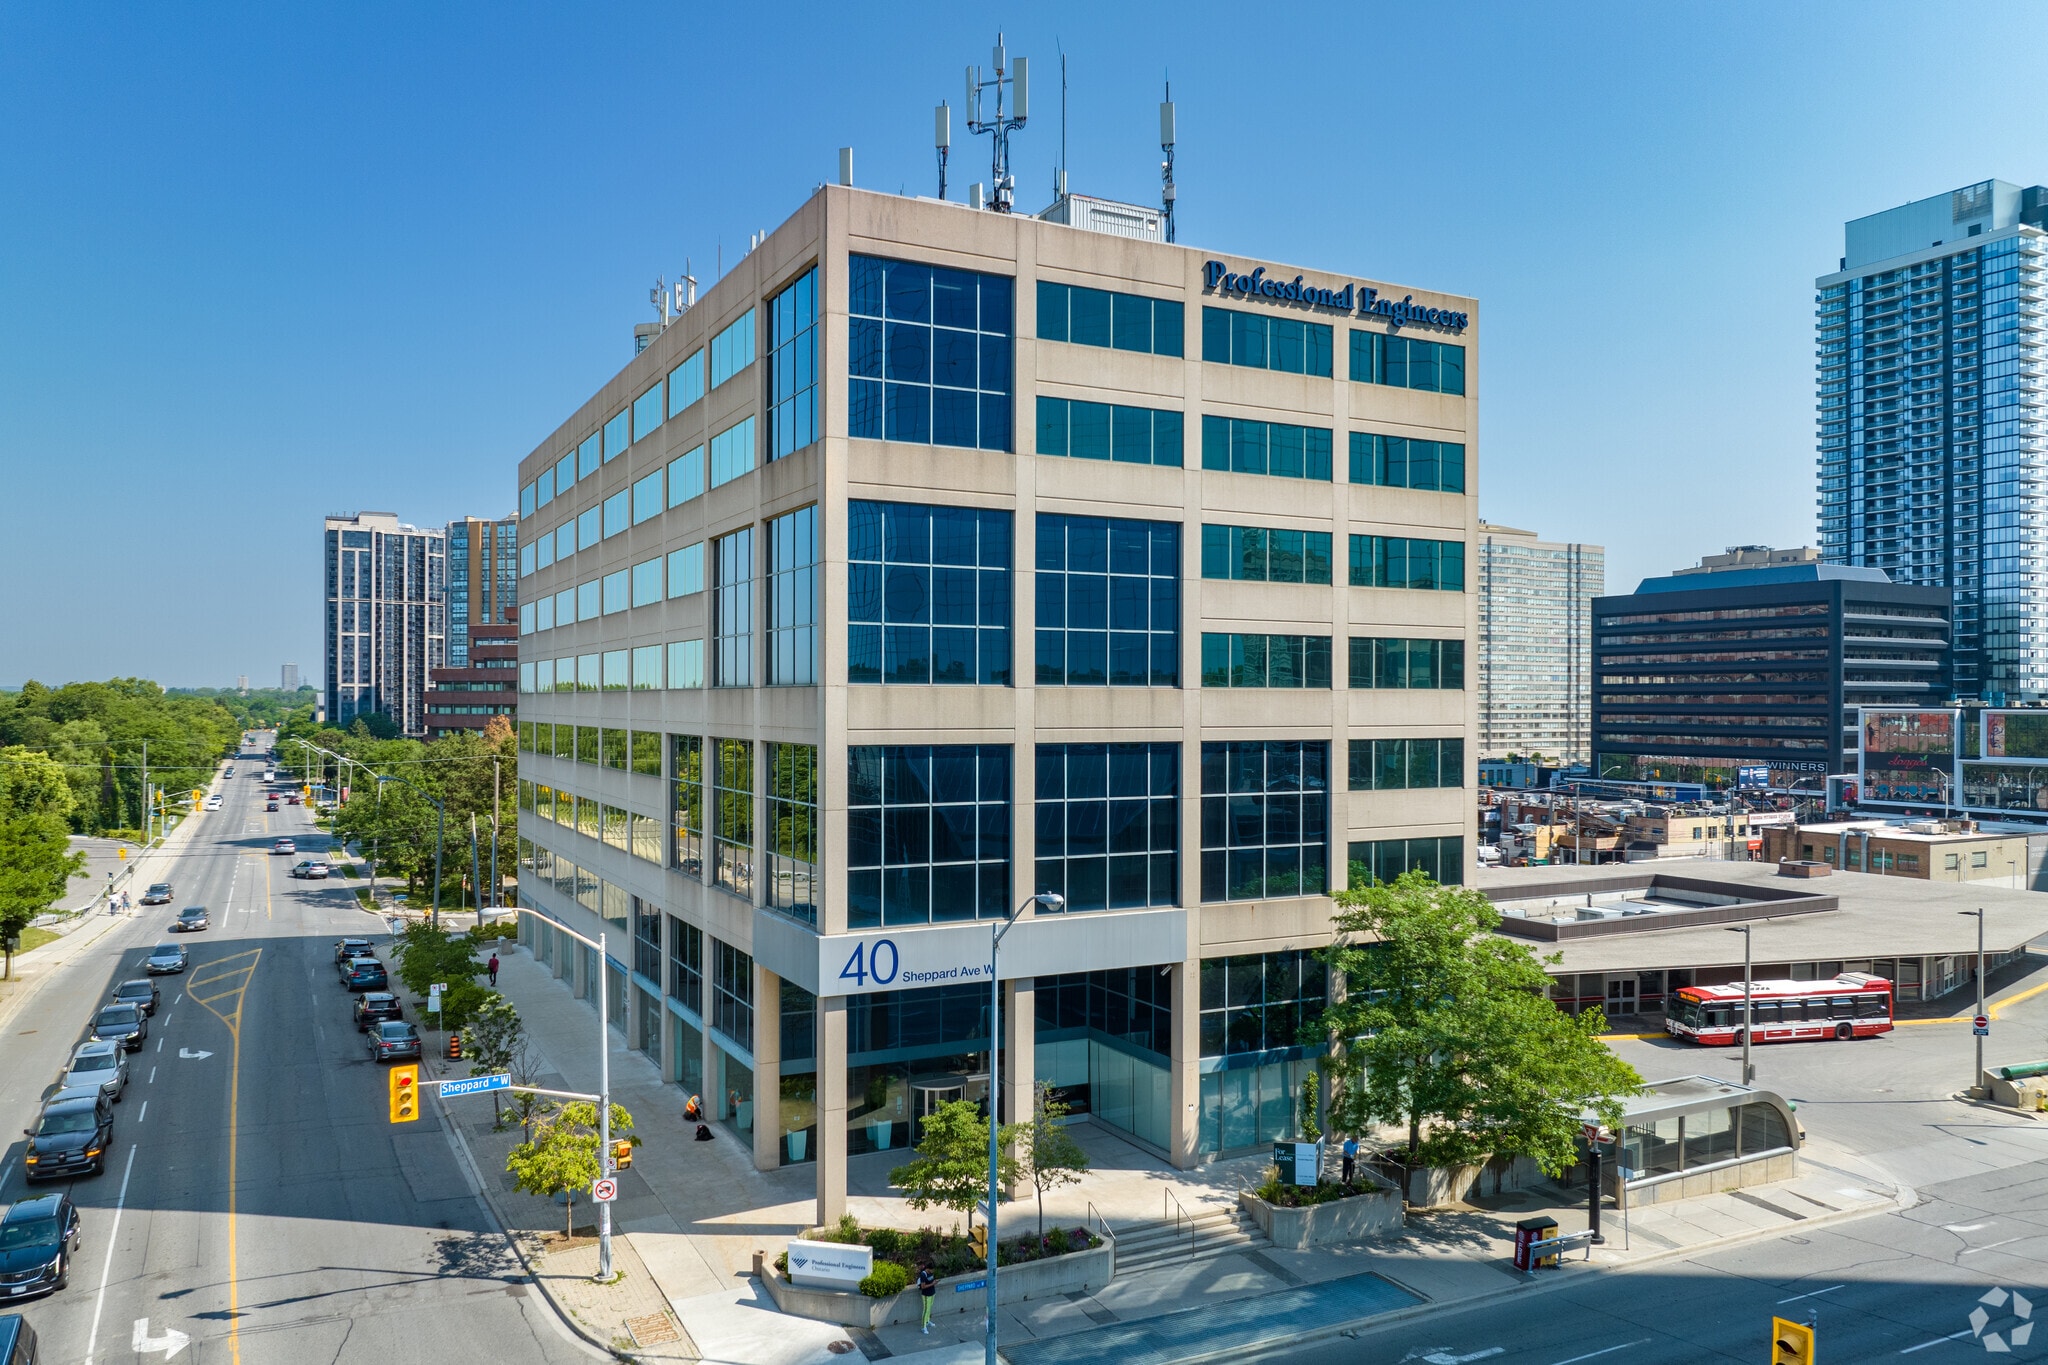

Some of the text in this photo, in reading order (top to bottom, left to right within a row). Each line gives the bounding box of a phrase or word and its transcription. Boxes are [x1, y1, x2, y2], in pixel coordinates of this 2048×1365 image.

[1206, 260, 1469, 330] Professional Engineers
[1766, 761, 1826, 772] WINNERS
[838, 939, 899, 987] 40
[902, 967, 958, 983] Sheppard
[960, 966, 981, 977] Ave
[441, 1078, 489, 1094] Sheppard
[500, 1075, 509, 1085] W
[811, 1259, 866, 1271] Professional Engineers
